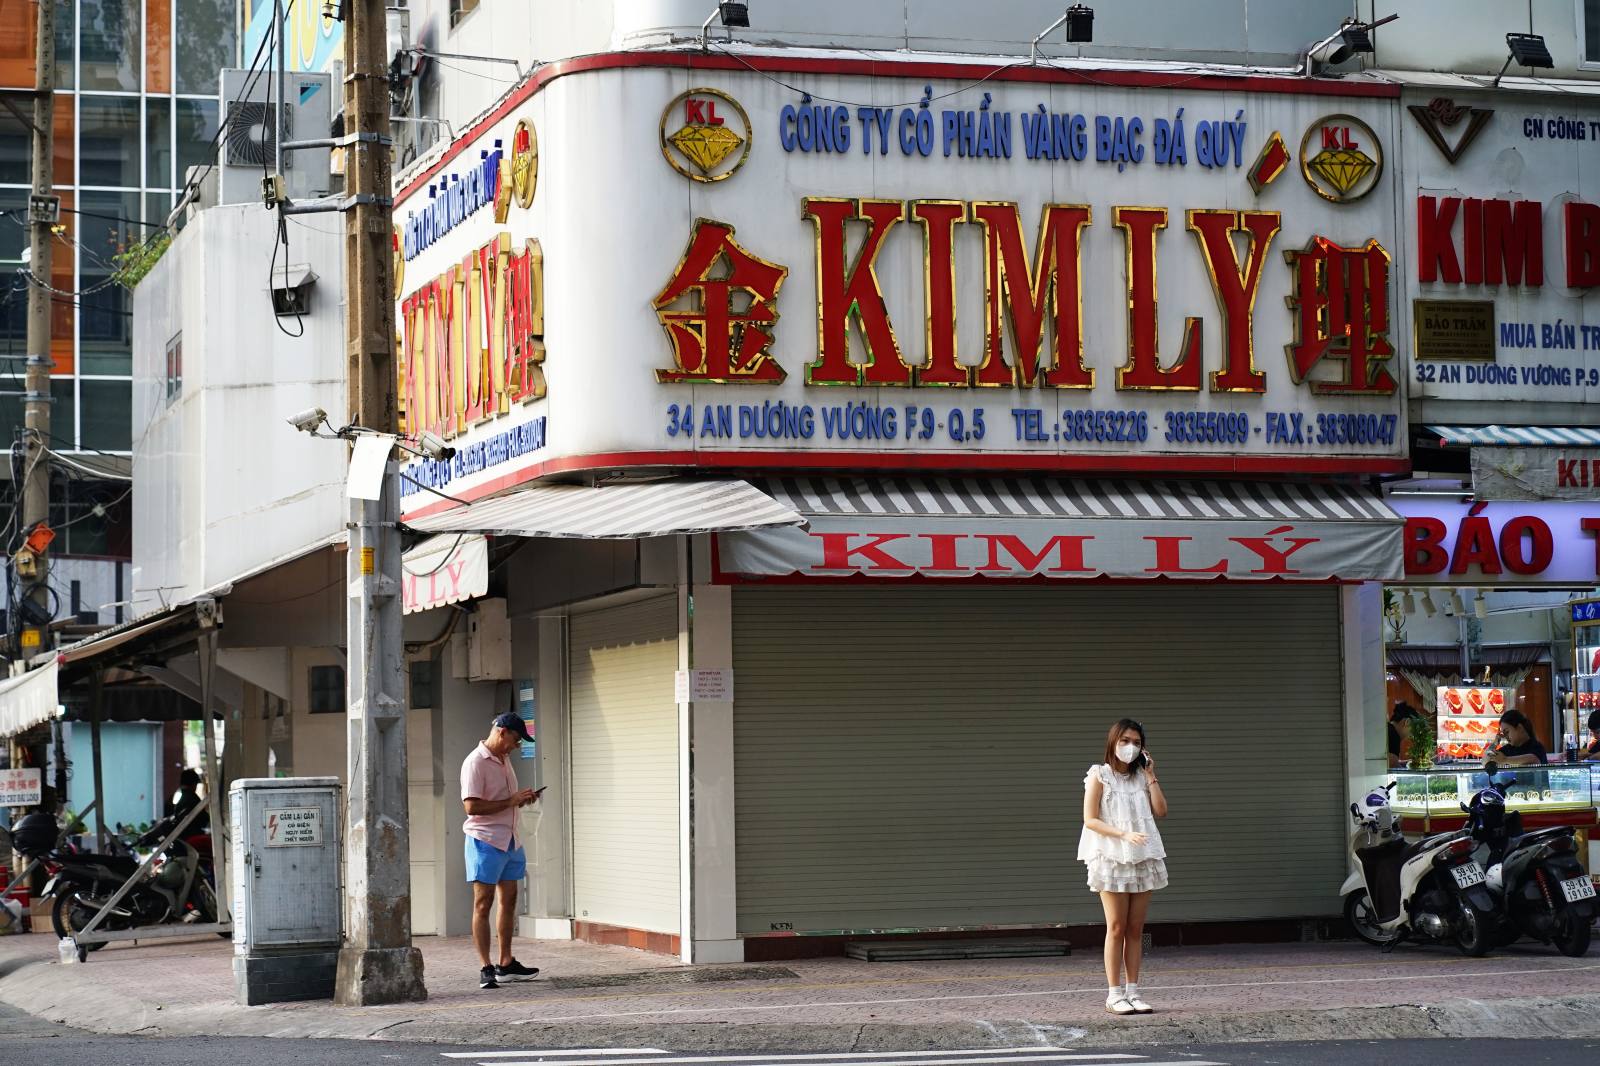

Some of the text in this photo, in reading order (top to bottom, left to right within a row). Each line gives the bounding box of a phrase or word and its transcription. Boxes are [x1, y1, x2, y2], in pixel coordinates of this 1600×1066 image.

[686, 98, 725, 126] KL
[780, 84, 1248, 173] CÔNG TY CỔ PHẦN VÀNG BẠC ĐÁ QUÝ
[1523, 117, 1543, 139] CN
[1547, 115, 1587, 141] CÔNG
[1321, 126, 1359, 151] KL
[1418, 195, 1543, 288] KIM
[652, 217, 788, 384] 金
[801, 196, 1095, 391] KIM
[1501, 322, 1536, 348] MUA
[1541, 318, 1575, 349] BÁN
[1416, 364, 1435, 383] 32
[1439, 364, 1461, 384] AN
[1466, 362, 1517, 386] DƯƠNG
[1521, 364, 1571, 387] VƯƠNG
[667, 404, 694, 438] 34
[701, 405, 732, 439] AN
[739, 401, 815, 441] DƯƠNG
[822, 401, 897, 441] VƯƠNG
[808, 525, 1321, 573] KIM LÝ
